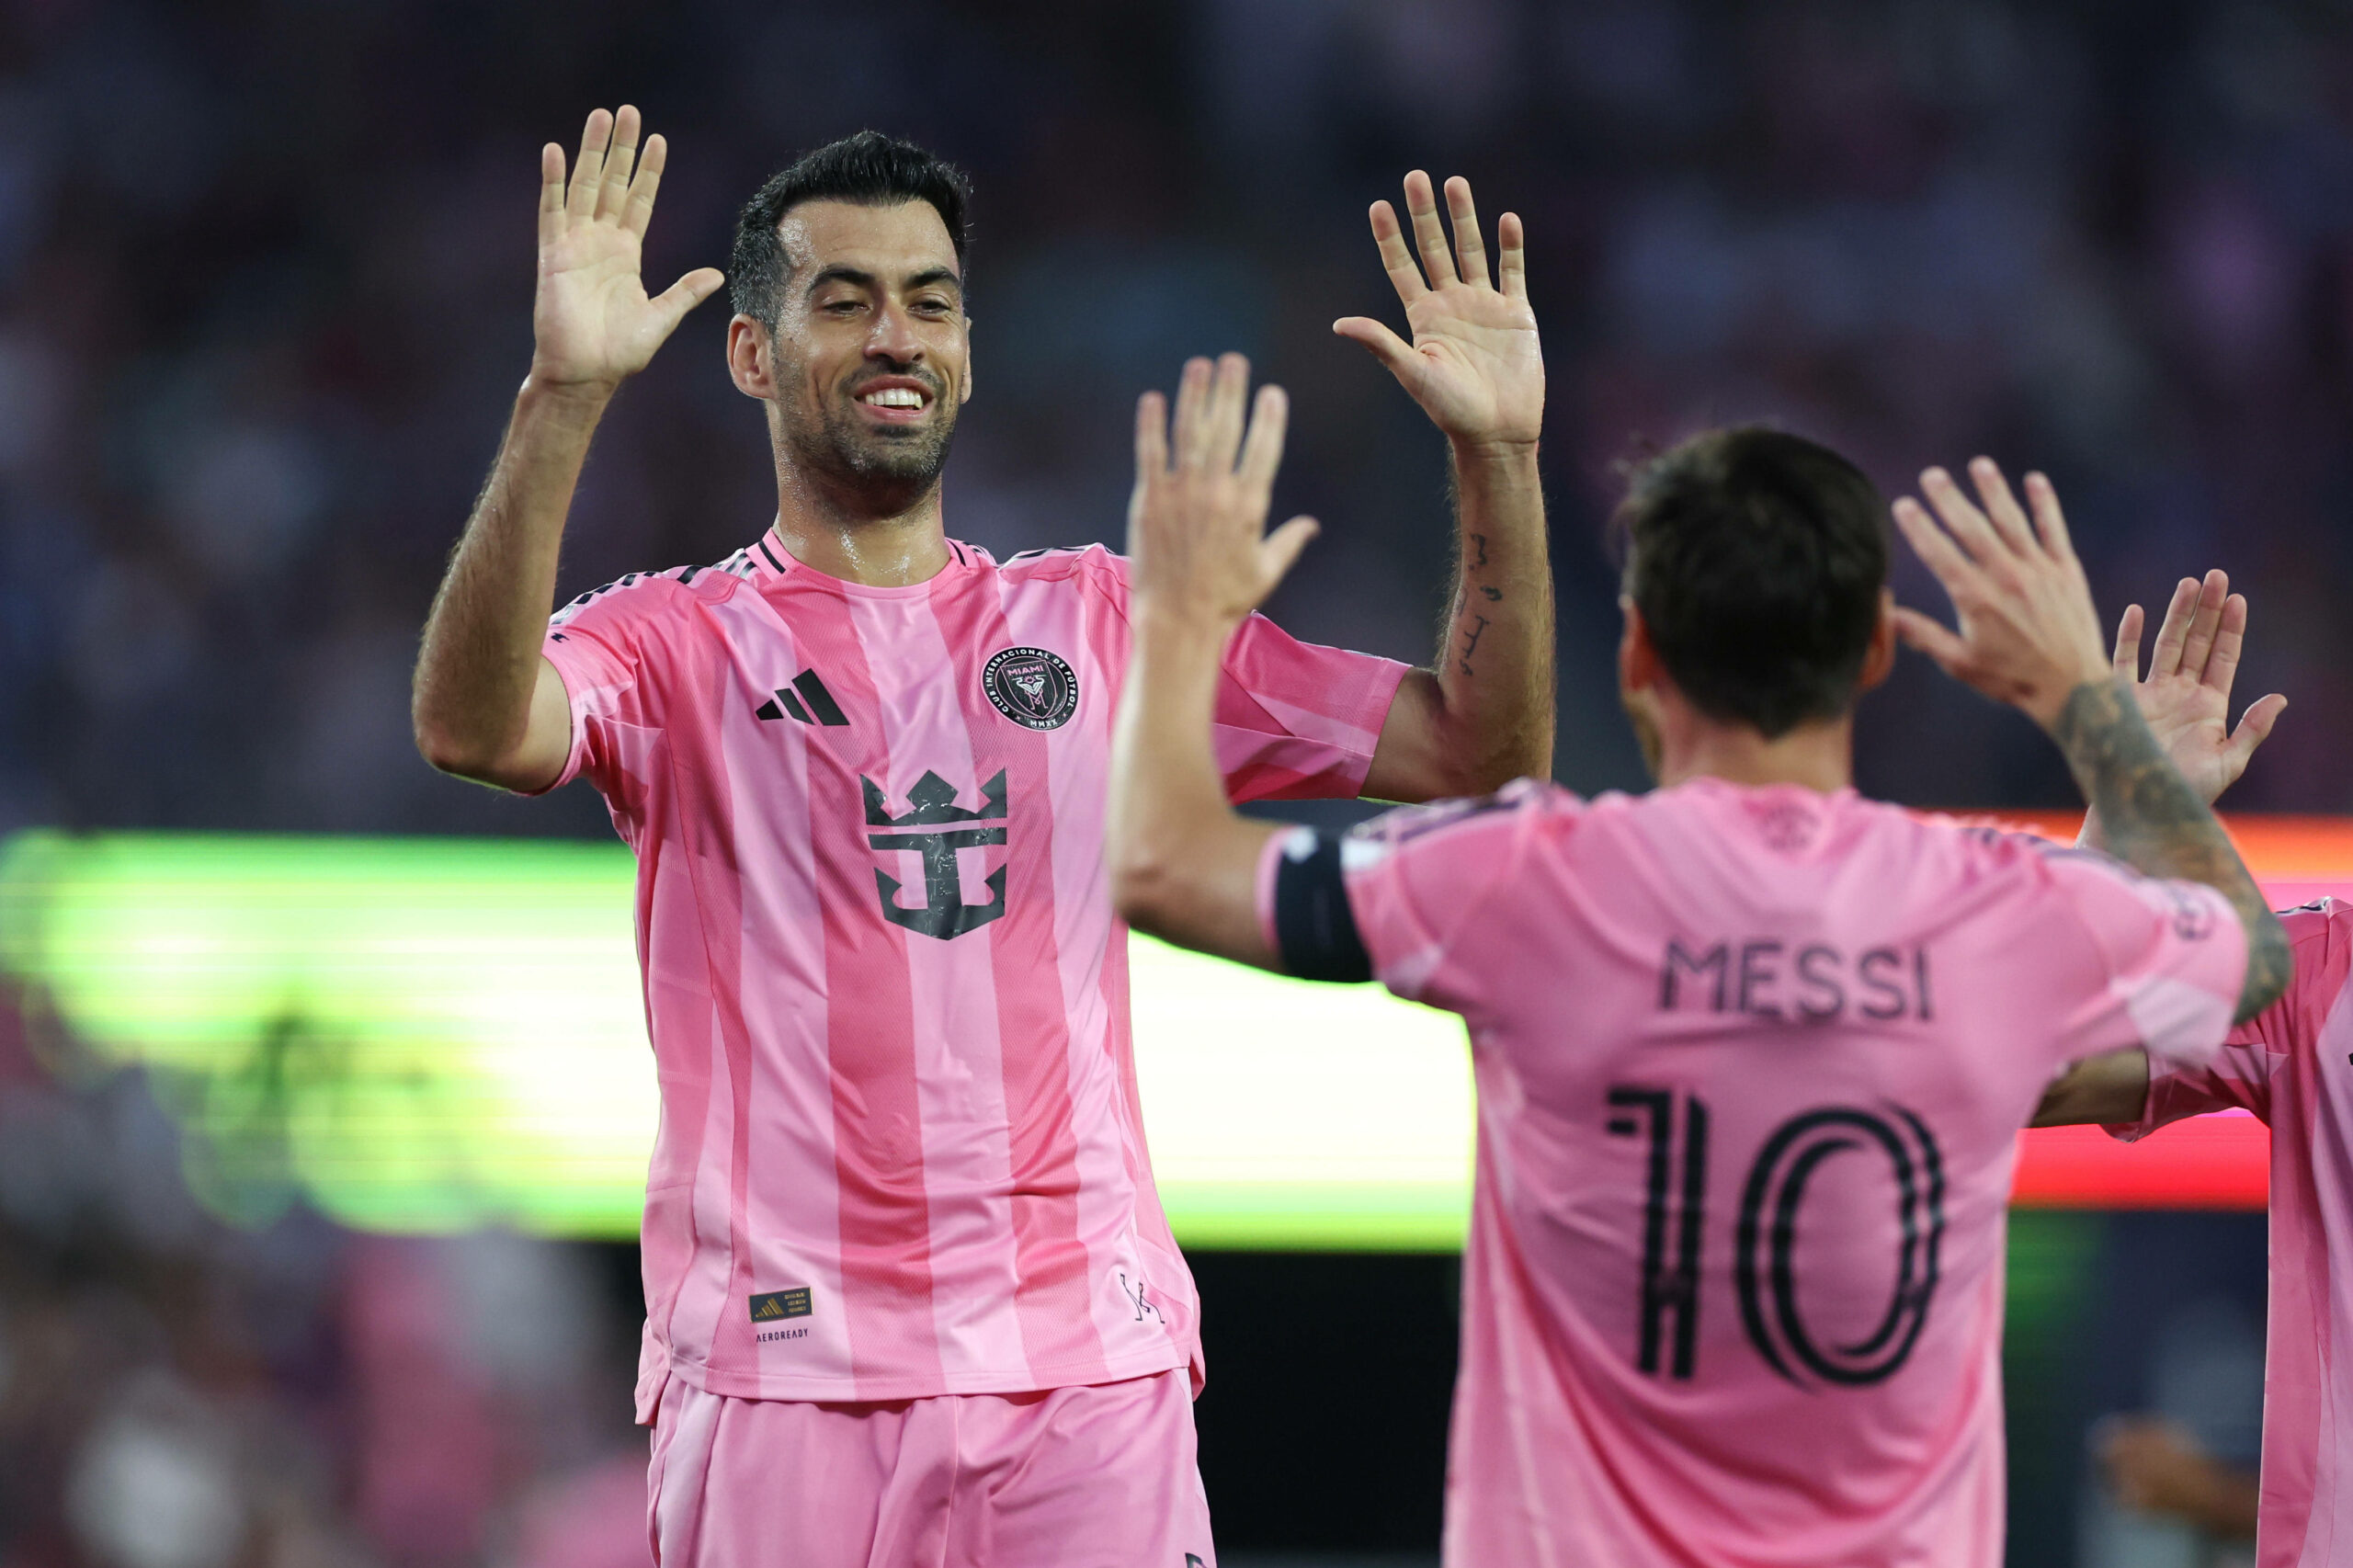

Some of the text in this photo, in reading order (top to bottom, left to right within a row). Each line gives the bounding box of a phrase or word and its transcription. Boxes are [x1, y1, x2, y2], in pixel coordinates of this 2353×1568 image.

[985, 649, 1050, 687] INTERNACIONAL
[1007, 665, 1044, 676] MIAMI
[1052, 658, 1066, 669] DE
[989, 690, 1009, 712] CLUB
[1029, 718, 1058, 728] MMXX
[1661, 938, 1935, 1021] MESSI
[1606, 1086, 1946, 1397] 10
[756, 1328, 808, 1343] AEROREADY
